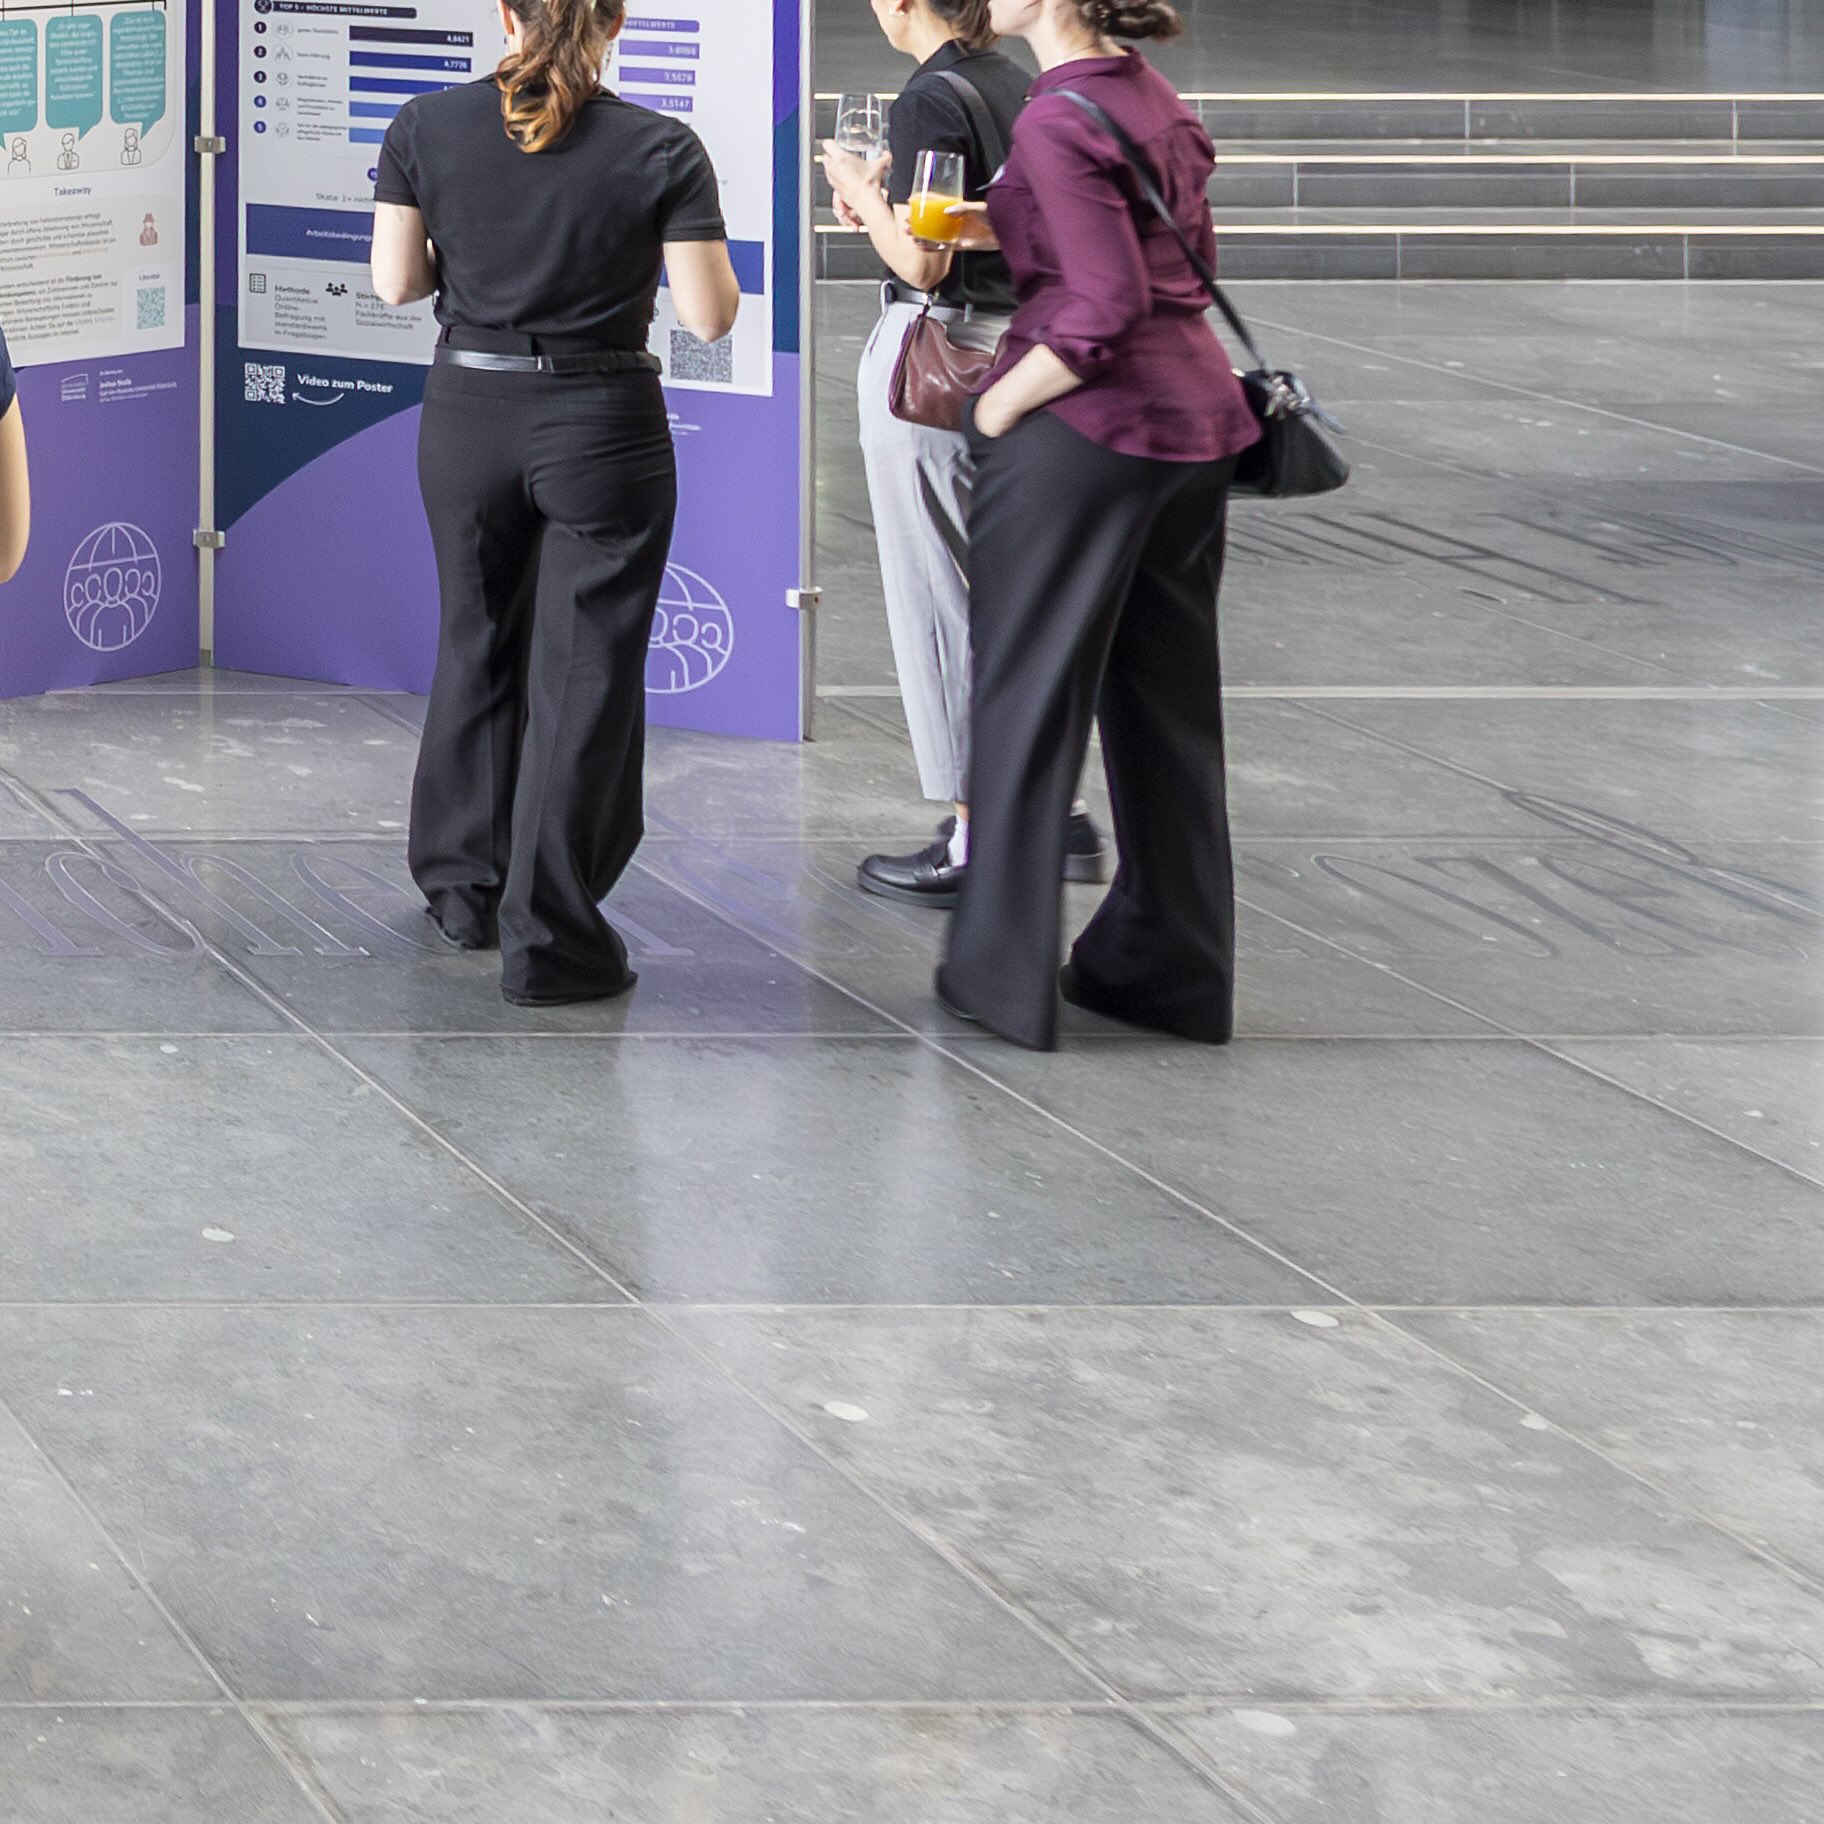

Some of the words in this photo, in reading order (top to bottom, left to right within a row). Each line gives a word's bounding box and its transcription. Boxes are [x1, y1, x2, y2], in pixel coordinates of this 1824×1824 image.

[297, 374, 329, 387] Video
[331, 379, 355, 389] zum
[356, 379, 393, 393] Poster
